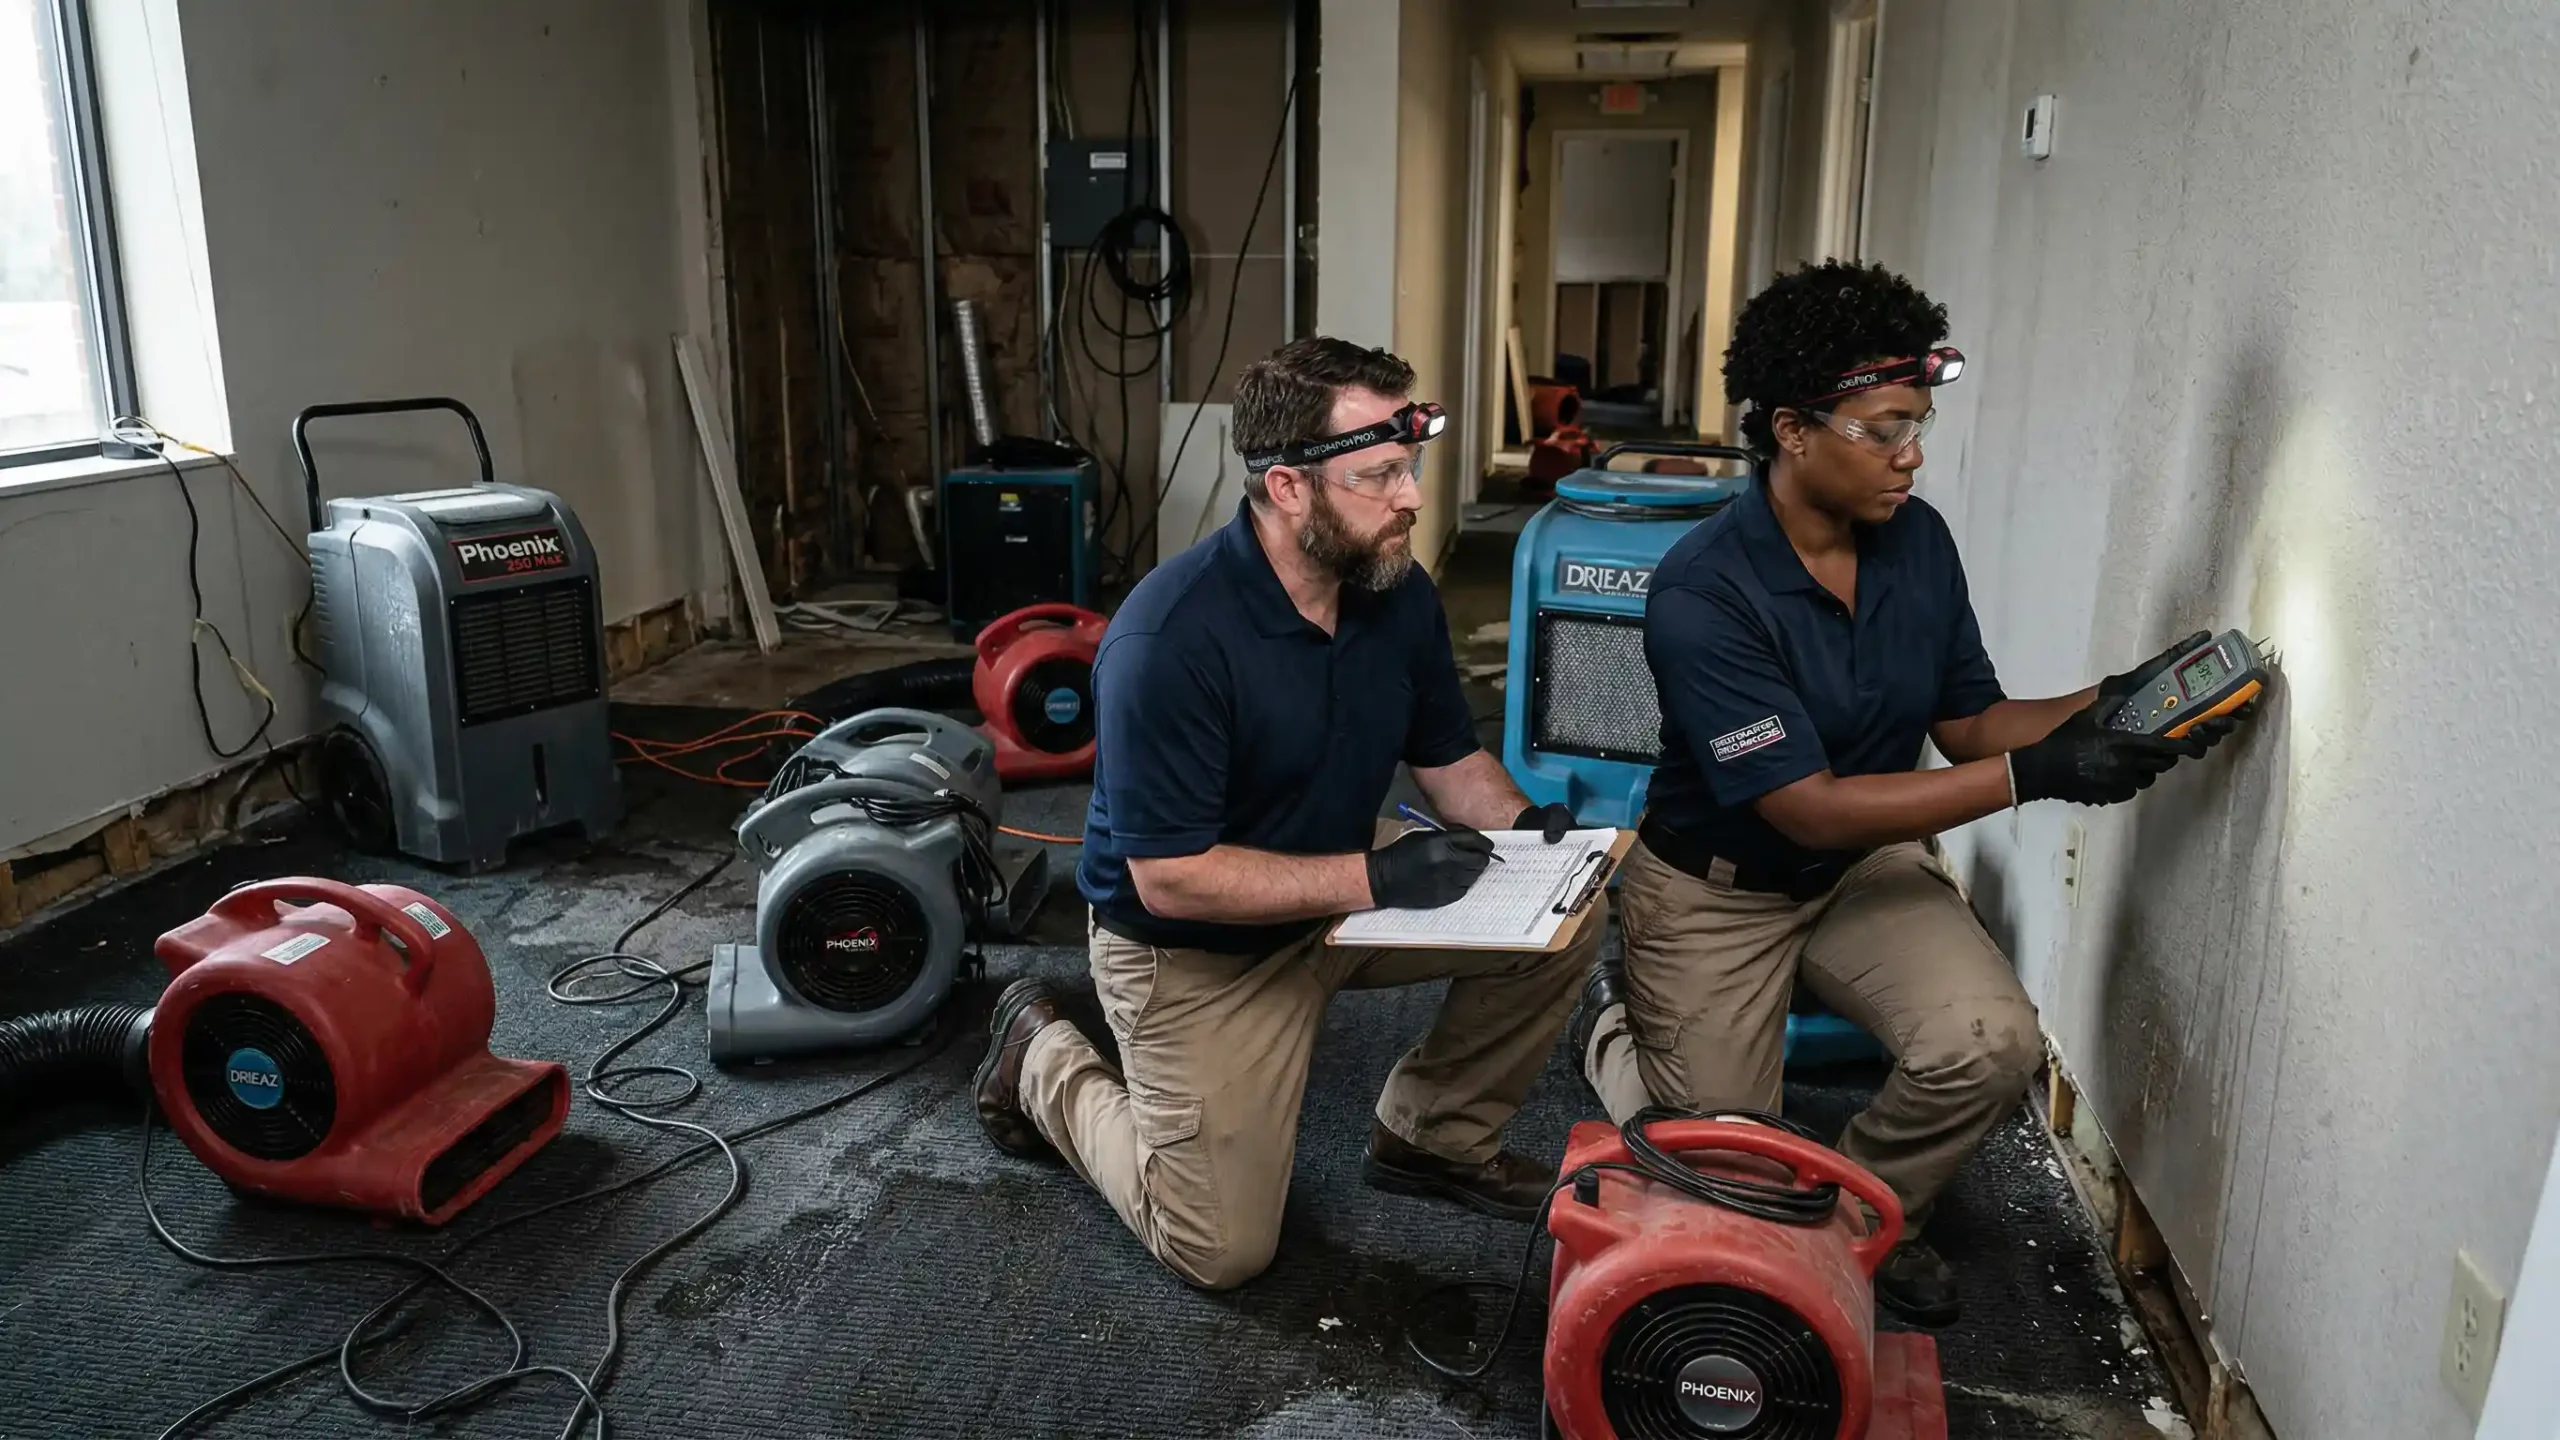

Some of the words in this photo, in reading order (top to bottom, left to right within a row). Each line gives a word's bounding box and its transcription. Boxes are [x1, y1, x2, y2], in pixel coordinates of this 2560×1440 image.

[458, 535, 559, 565] Phoenix
[507, 557, 532, 572] 250
[1565, 564, 1650, 594] DRIEAZ
[826, 937, 876, 950] PHOENIX
[230, 1069, 279, 1088] DRIEAZ
[1681, 1381, 1756, 1405] PHOENIX
